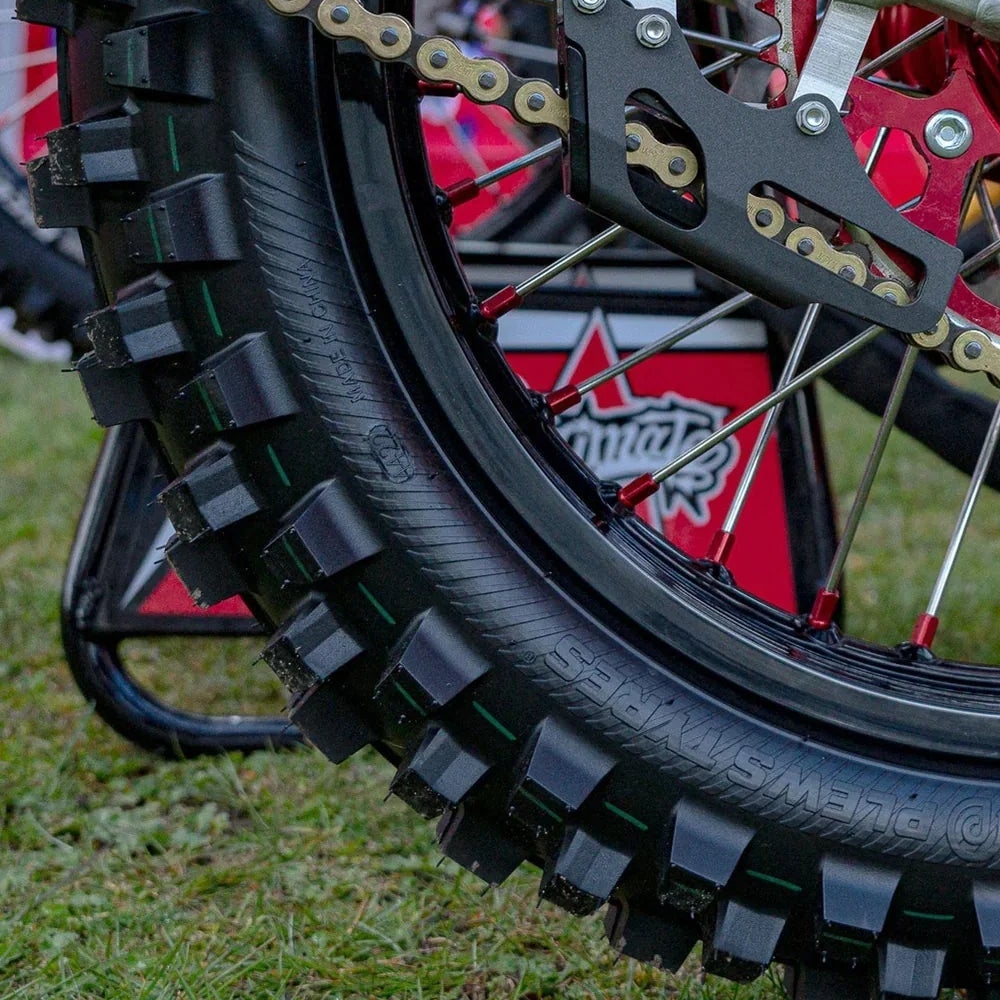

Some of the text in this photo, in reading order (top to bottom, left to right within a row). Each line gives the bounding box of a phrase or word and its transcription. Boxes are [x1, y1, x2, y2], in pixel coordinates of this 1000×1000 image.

[291, 257, 368, 405] MADE IN CHINA
[543, 633, 937, 843] PLEWS TYRES
